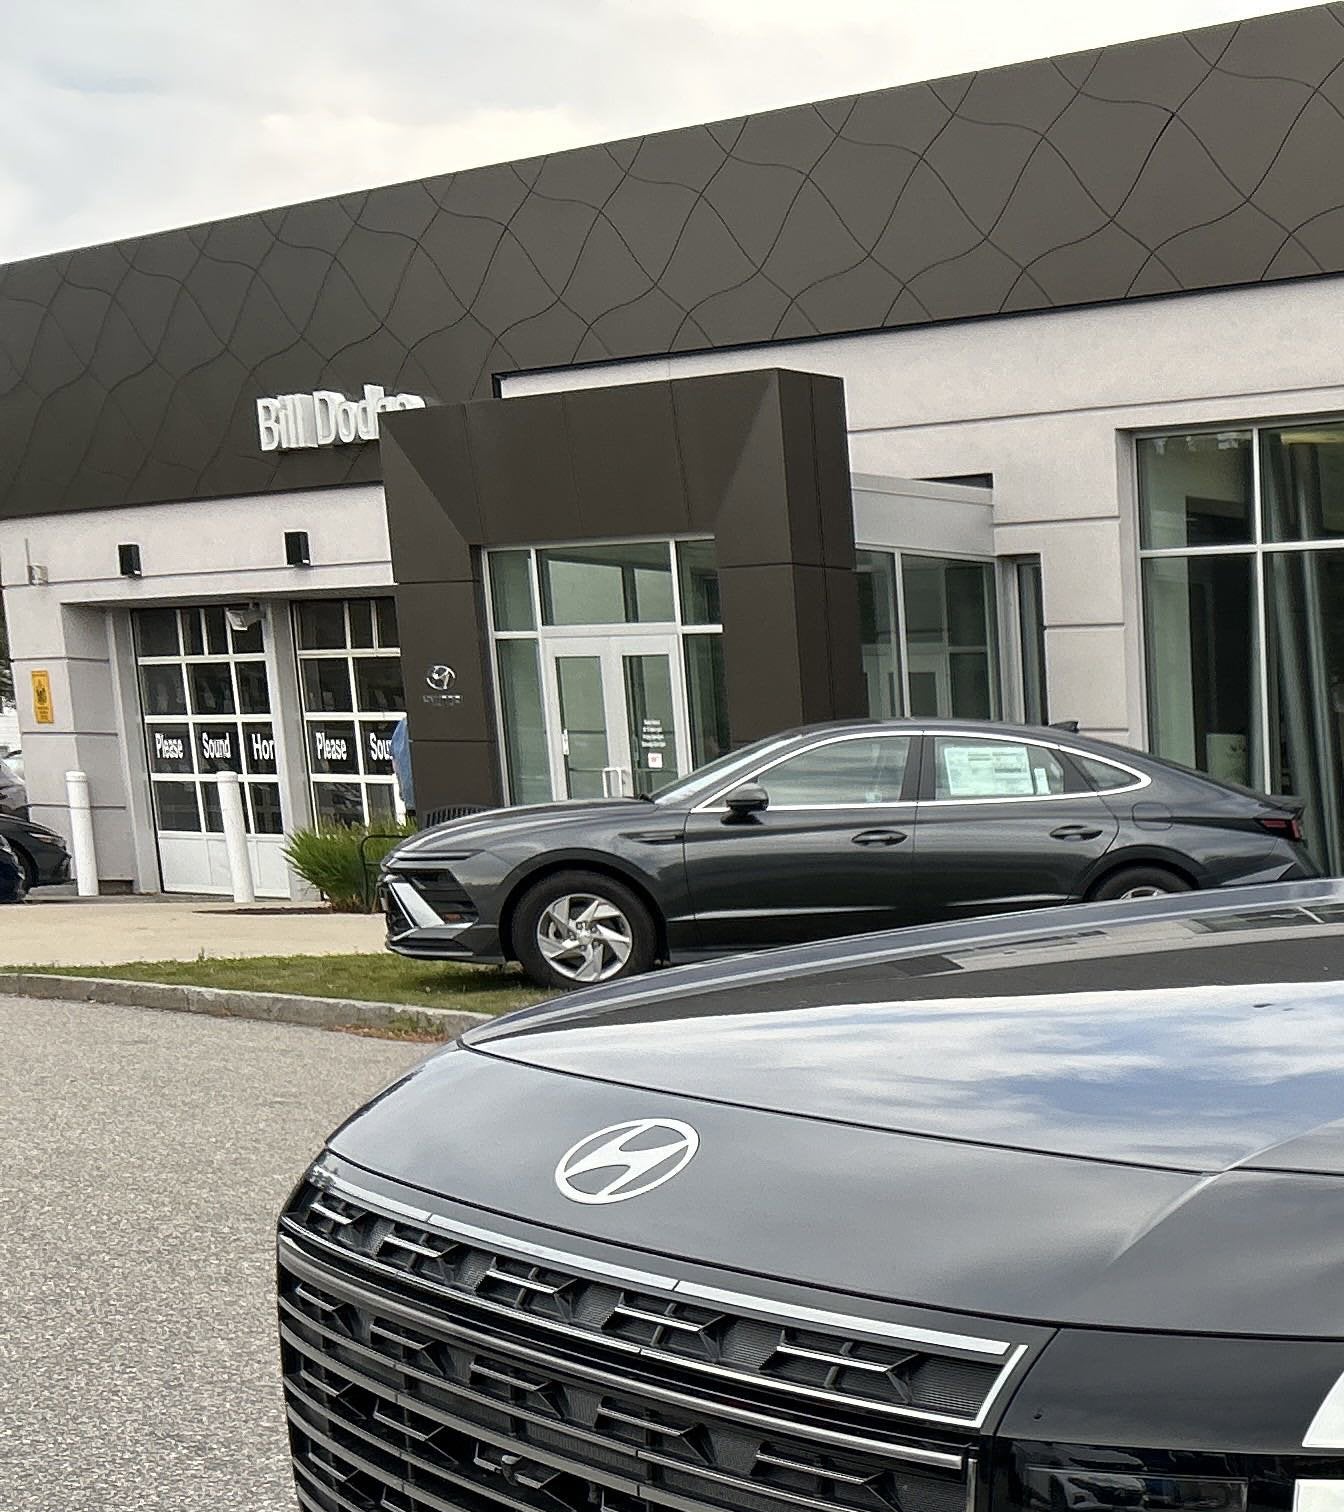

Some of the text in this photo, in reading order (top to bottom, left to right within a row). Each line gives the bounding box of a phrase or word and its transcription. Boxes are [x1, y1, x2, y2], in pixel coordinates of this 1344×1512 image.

[257, 384, 426, 451] Bill Dod
[155, 733, 183, 759] Please
[202, 732, 231, 759] Sound
[316, 731, 347, 760] Please
